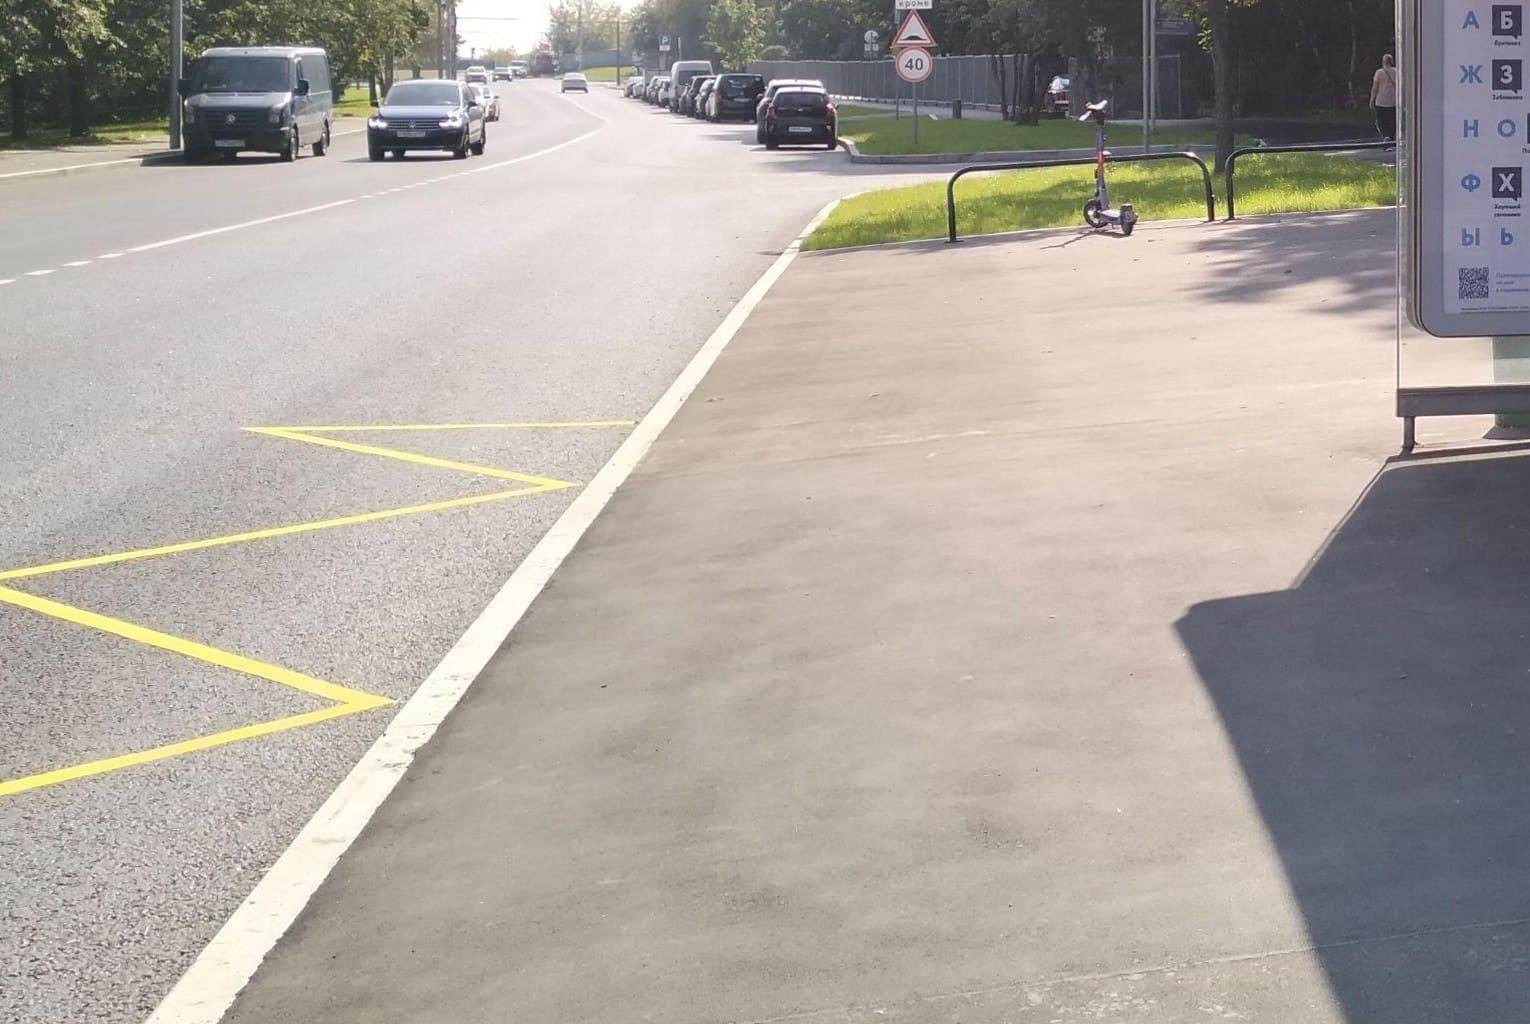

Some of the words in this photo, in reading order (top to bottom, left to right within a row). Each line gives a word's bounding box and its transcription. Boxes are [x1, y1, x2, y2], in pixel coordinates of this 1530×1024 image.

[1462, 11, 1480, 29] А
[1500, 10, 1513, 29] Б
[905, 58, 924, 71] 40
[1459, 65, 1483, 83] Ж
[1500, 65, 1513, 84] З
[1463, 119, 1478, 137] Н
[1497, 119, 1516, 137] О
[1461, 174, 1480, 192] Ф
[1498, 173, 1515, 192] Х
[1461, 227, 1480, 246] Ы
[1501, 228, 1513, 246] Ь
